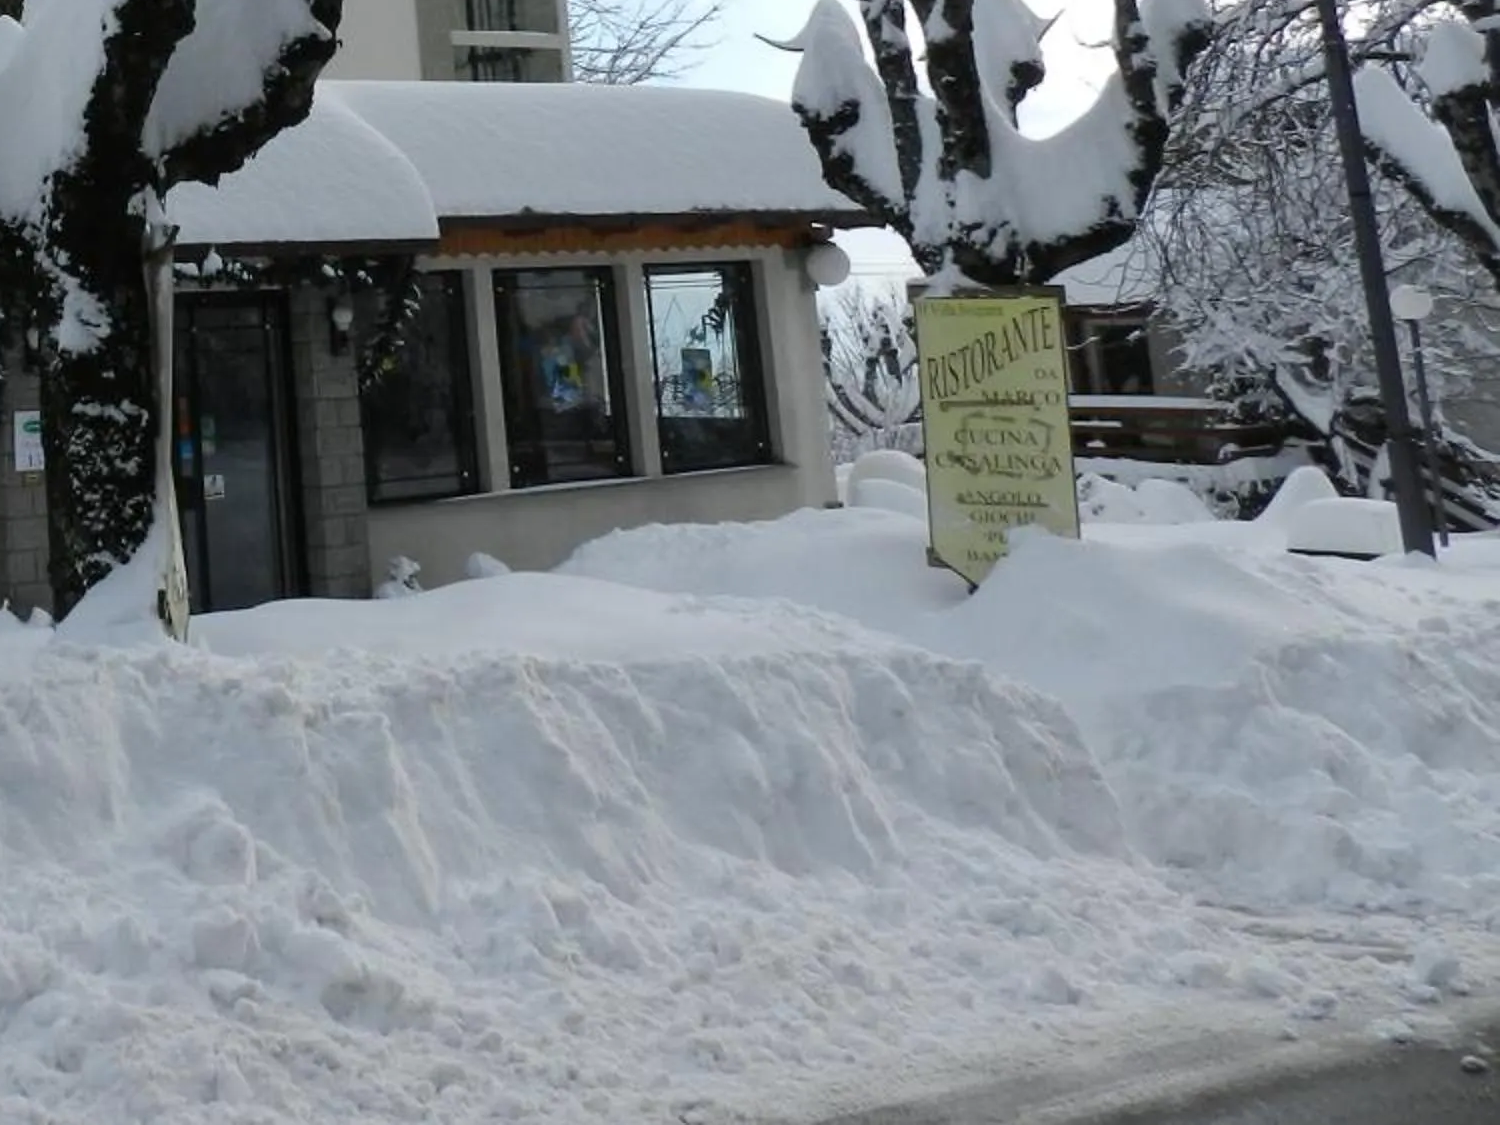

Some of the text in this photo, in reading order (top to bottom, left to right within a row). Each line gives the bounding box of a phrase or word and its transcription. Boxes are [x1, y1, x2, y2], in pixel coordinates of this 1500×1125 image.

[927, 306, 1054, 400] RISTORANTE
[1034, 367, 1059, 380] DA
[954, 428, 1039, 446] CUCINA
[935, 452, 1062, 473] CASALINGA
